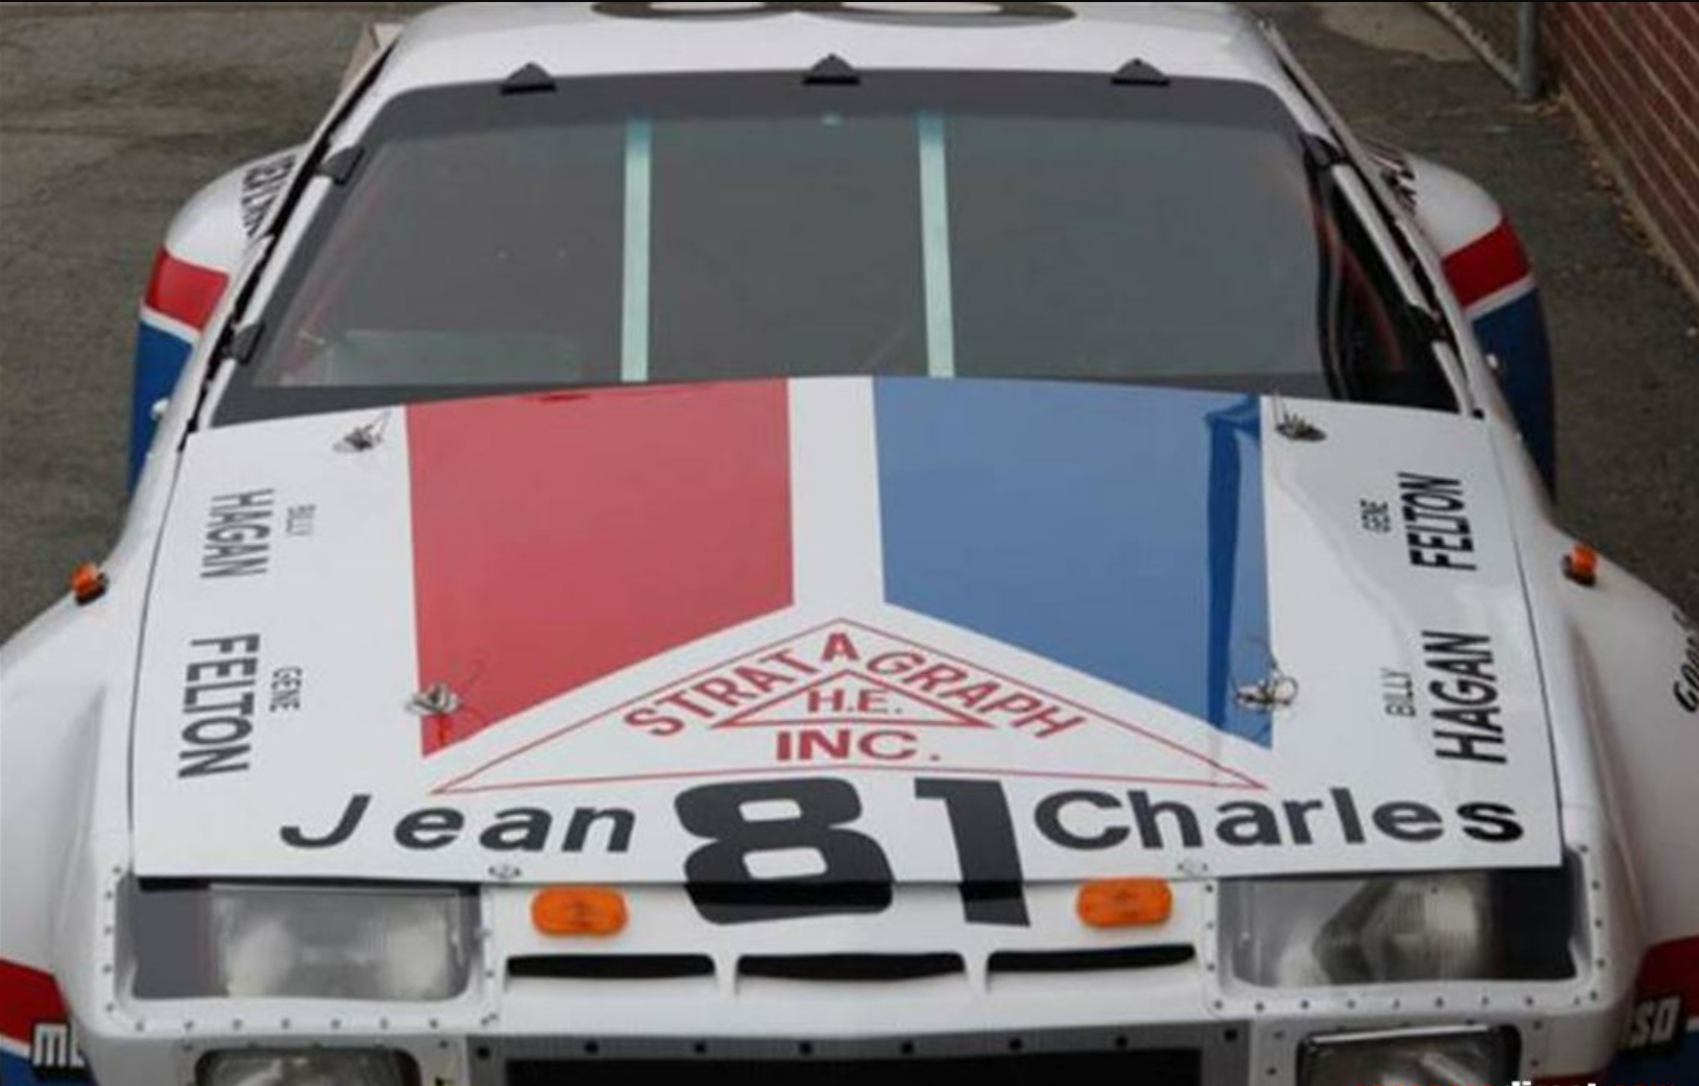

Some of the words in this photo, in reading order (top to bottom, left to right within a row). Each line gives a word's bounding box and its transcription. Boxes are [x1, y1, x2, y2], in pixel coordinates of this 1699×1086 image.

[200, 488, 275, 578] HAGAN
[1359, 498, 1391, 533] GENE
[1397, 472, 1477, 571] FELTON
[177, 632, 261, 779] FELTON
[269, 665, 303, 713] GENE
[806, 689, 903, 714] H.E.
[1380, 667, 1416, 718] BILLY
[1421, 630, 1507, 764] HAGAN
[776, 730, 941, 761] INC.
[279, 793, 636, 853] Jean
[673, 777, 1031, 927] 81
[1034, 787, 1524, 850] Charles
